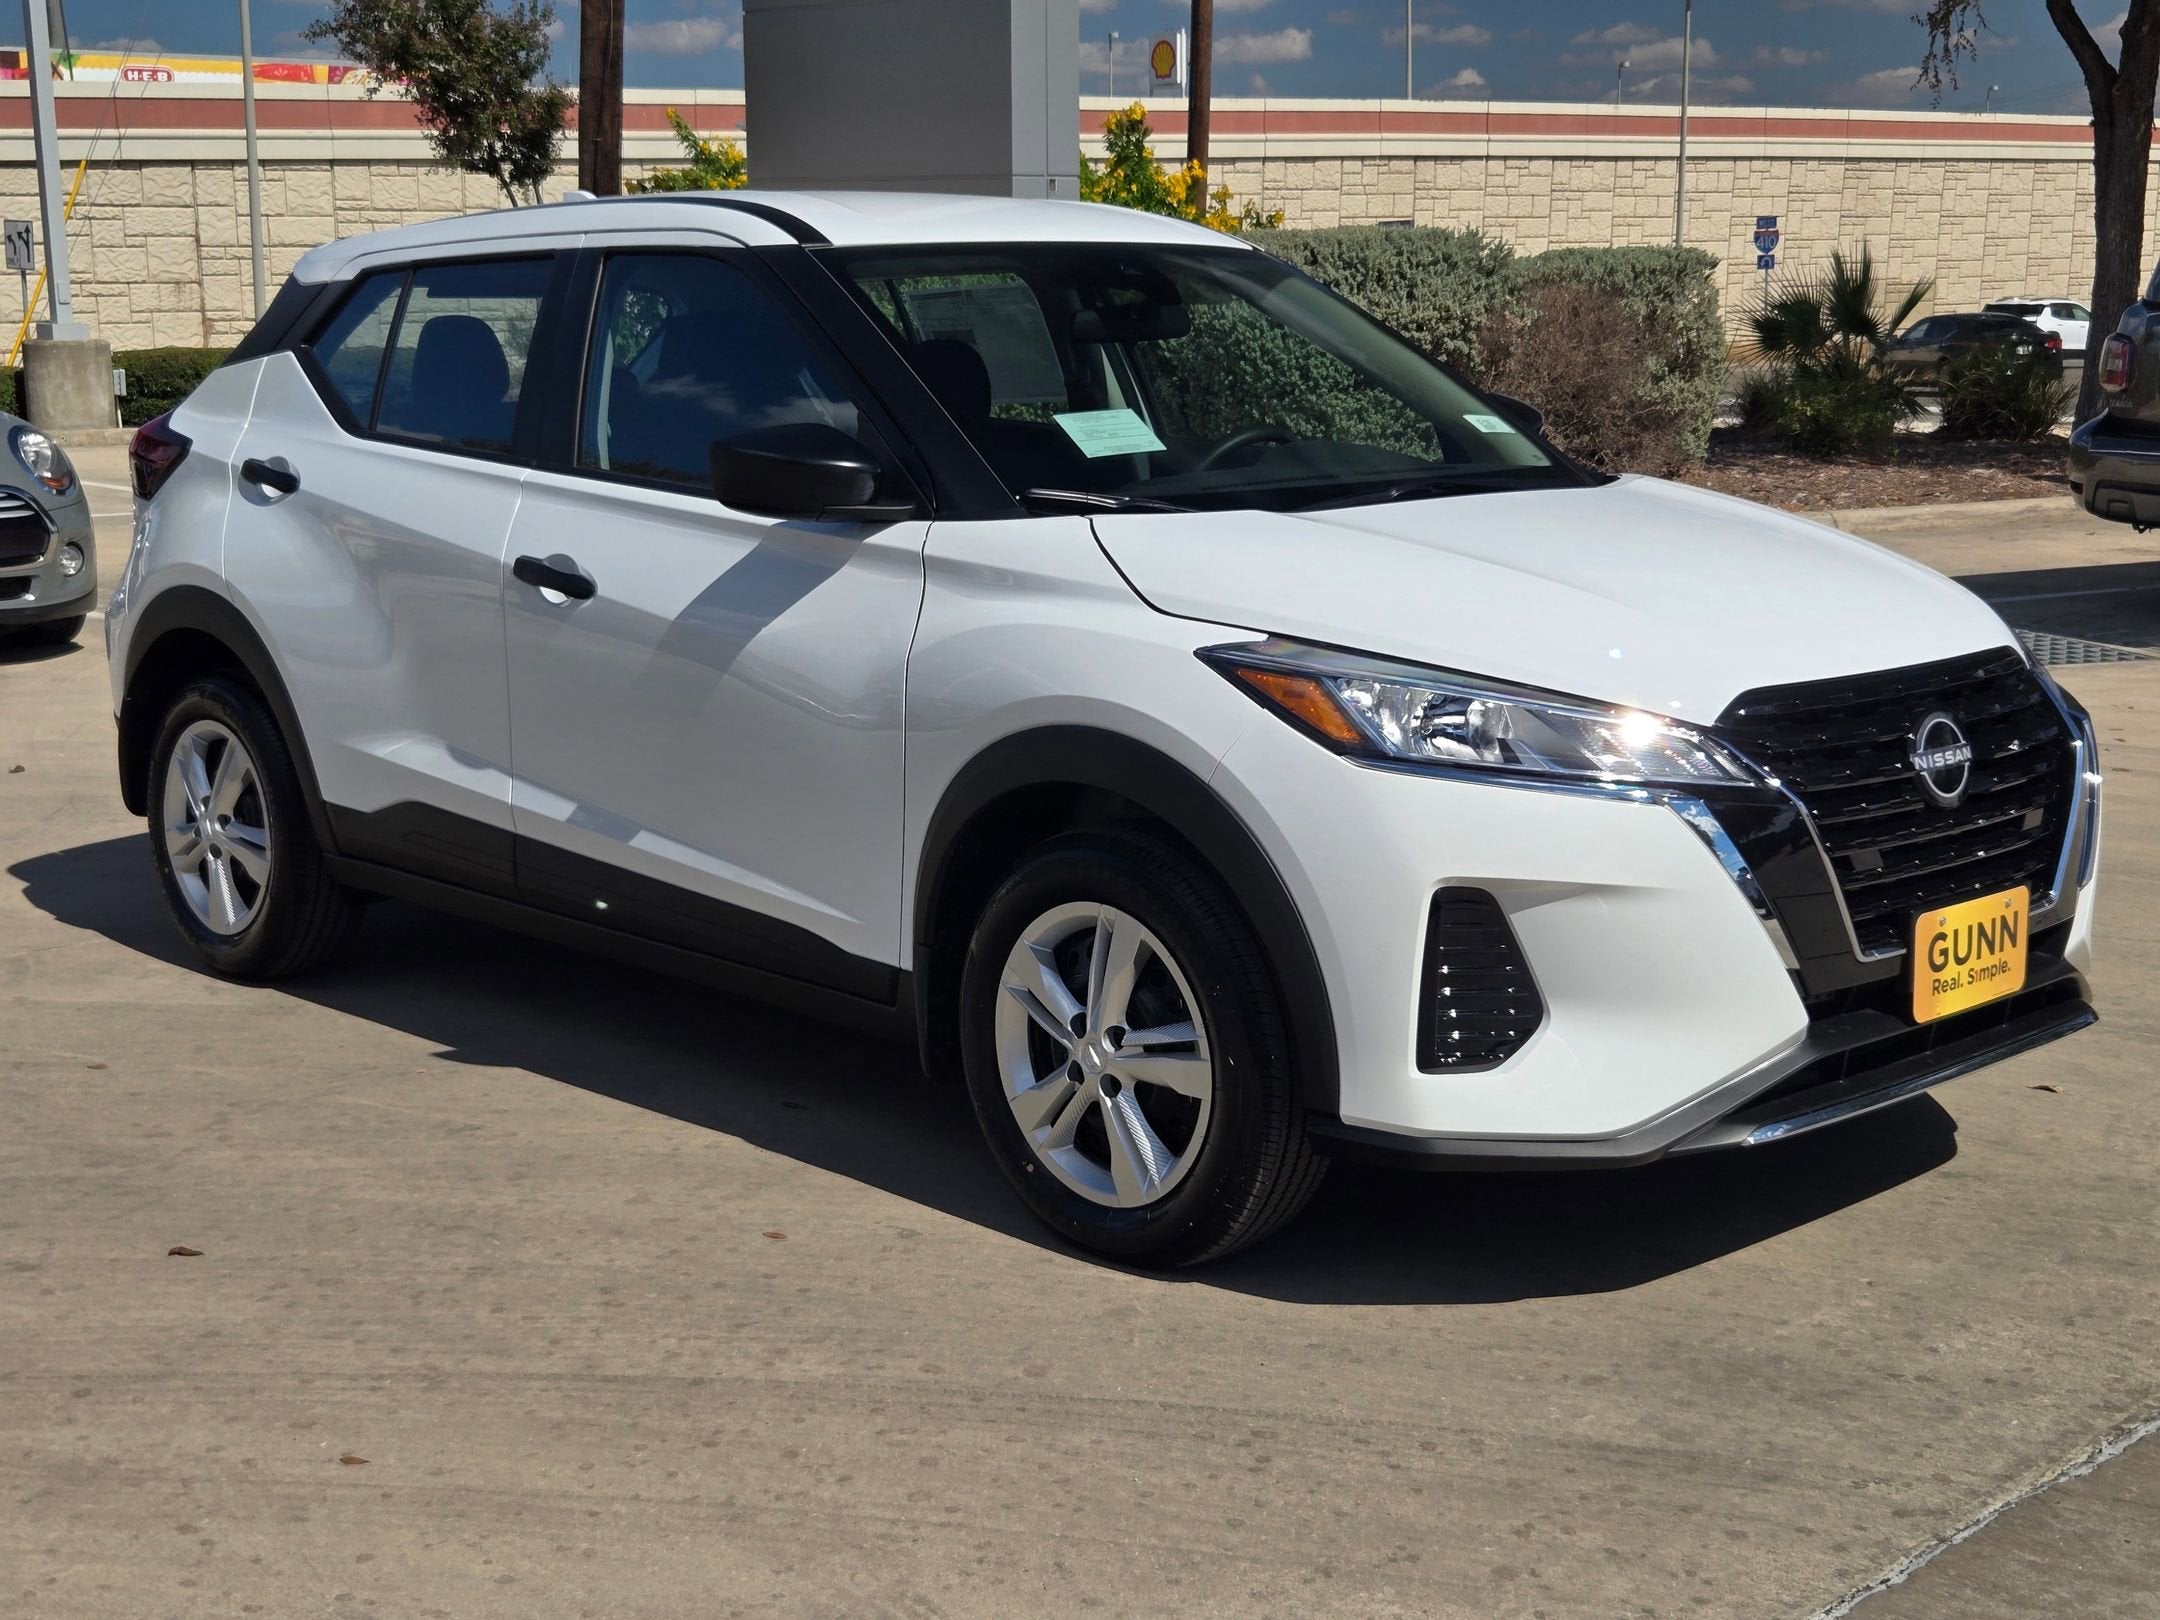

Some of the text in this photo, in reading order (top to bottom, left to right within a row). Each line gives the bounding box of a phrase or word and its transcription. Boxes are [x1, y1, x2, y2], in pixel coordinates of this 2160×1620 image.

[1756, 235, 1777, 249] 410
[1913, 745, 1972, 771] NISSAN
[1927, 910, 2019, 973] GUNN
[1932, 971, 1964, 997] Real.
